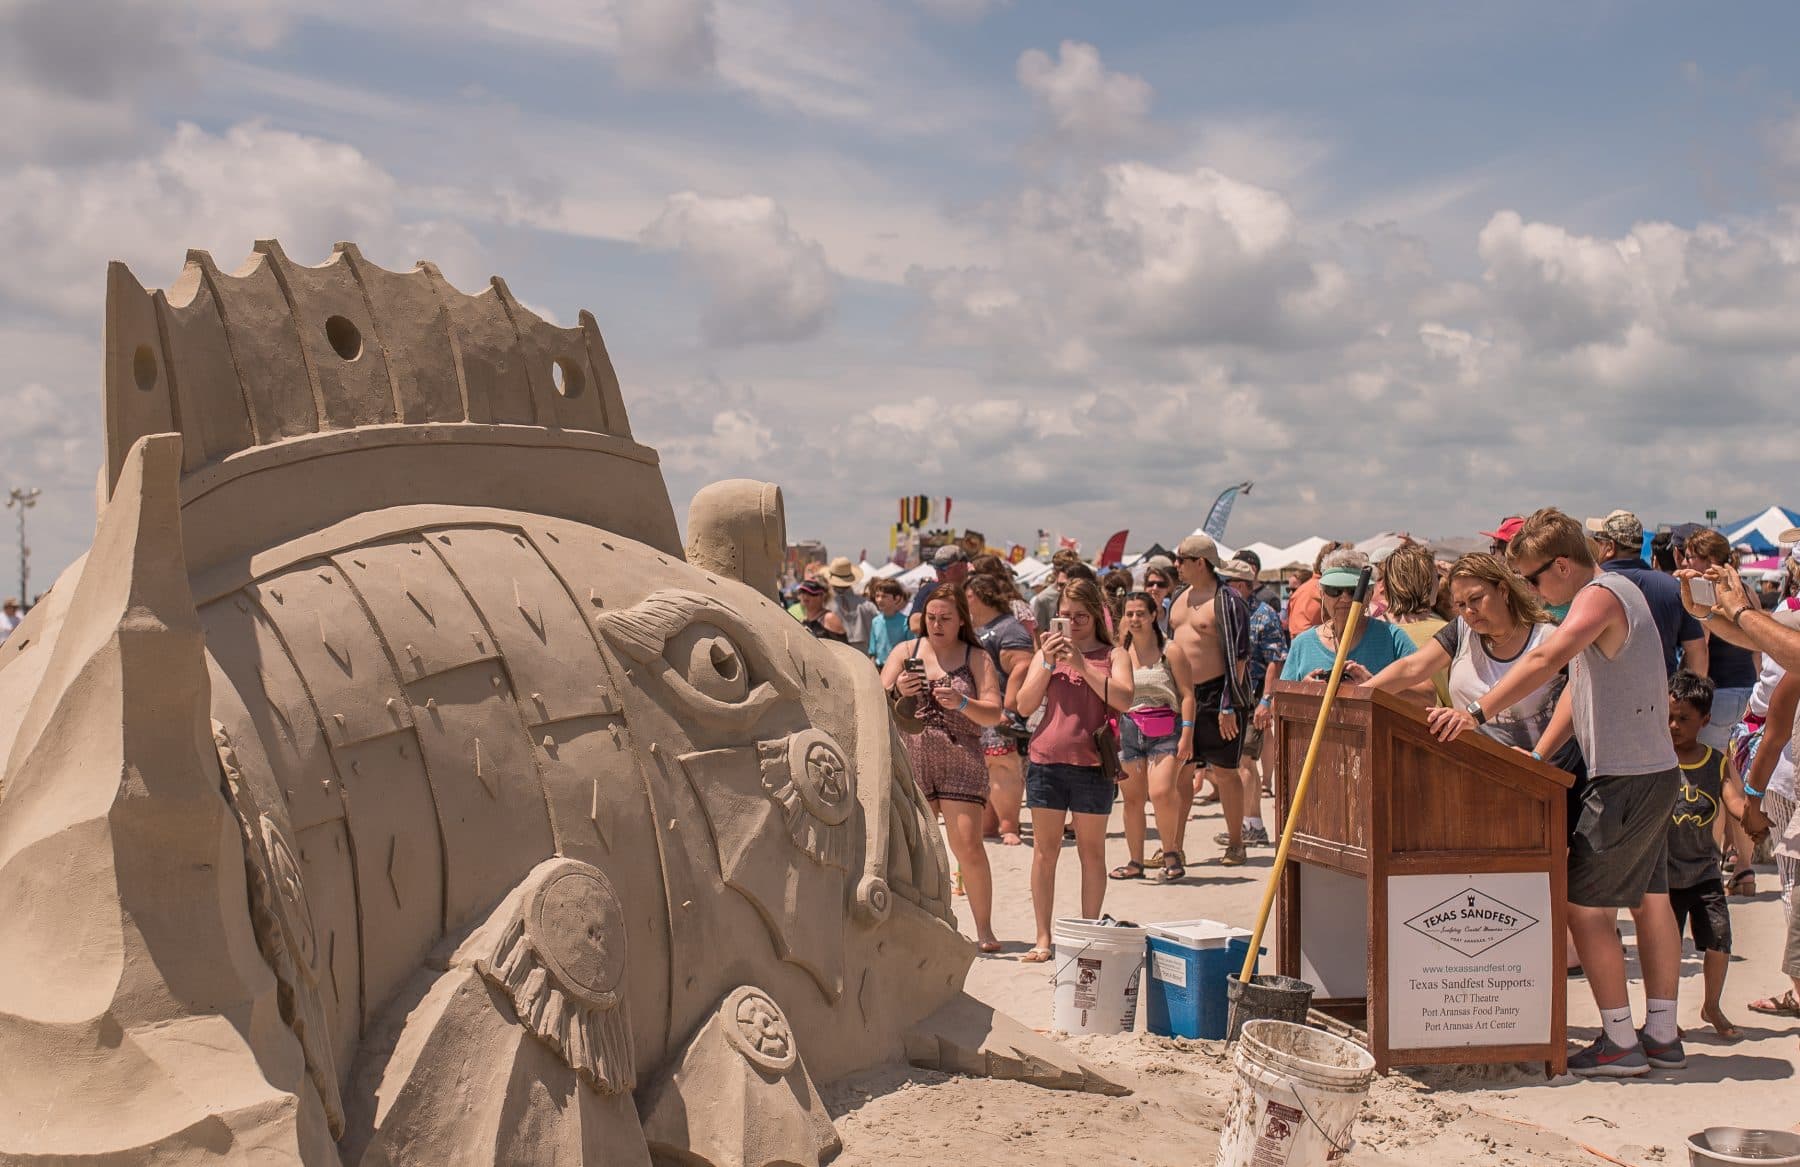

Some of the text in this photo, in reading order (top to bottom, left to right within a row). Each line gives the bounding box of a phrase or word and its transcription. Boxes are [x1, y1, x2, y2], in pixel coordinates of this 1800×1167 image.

[1423, 909, 1518, 928] TEXAS SANDFEST
[1422, 963, 1521, 974] www.texassandfest.org
[1409, 978, 1535, 990] Texas Sandfest Supports:
[1444, 994, 1499, 1003] PACT Theatre
[1422, 1006, 1520, 1017] Port Aransas Food Pantry
[1425, 1020, 1516, 1031] Port Aransas Art Center
